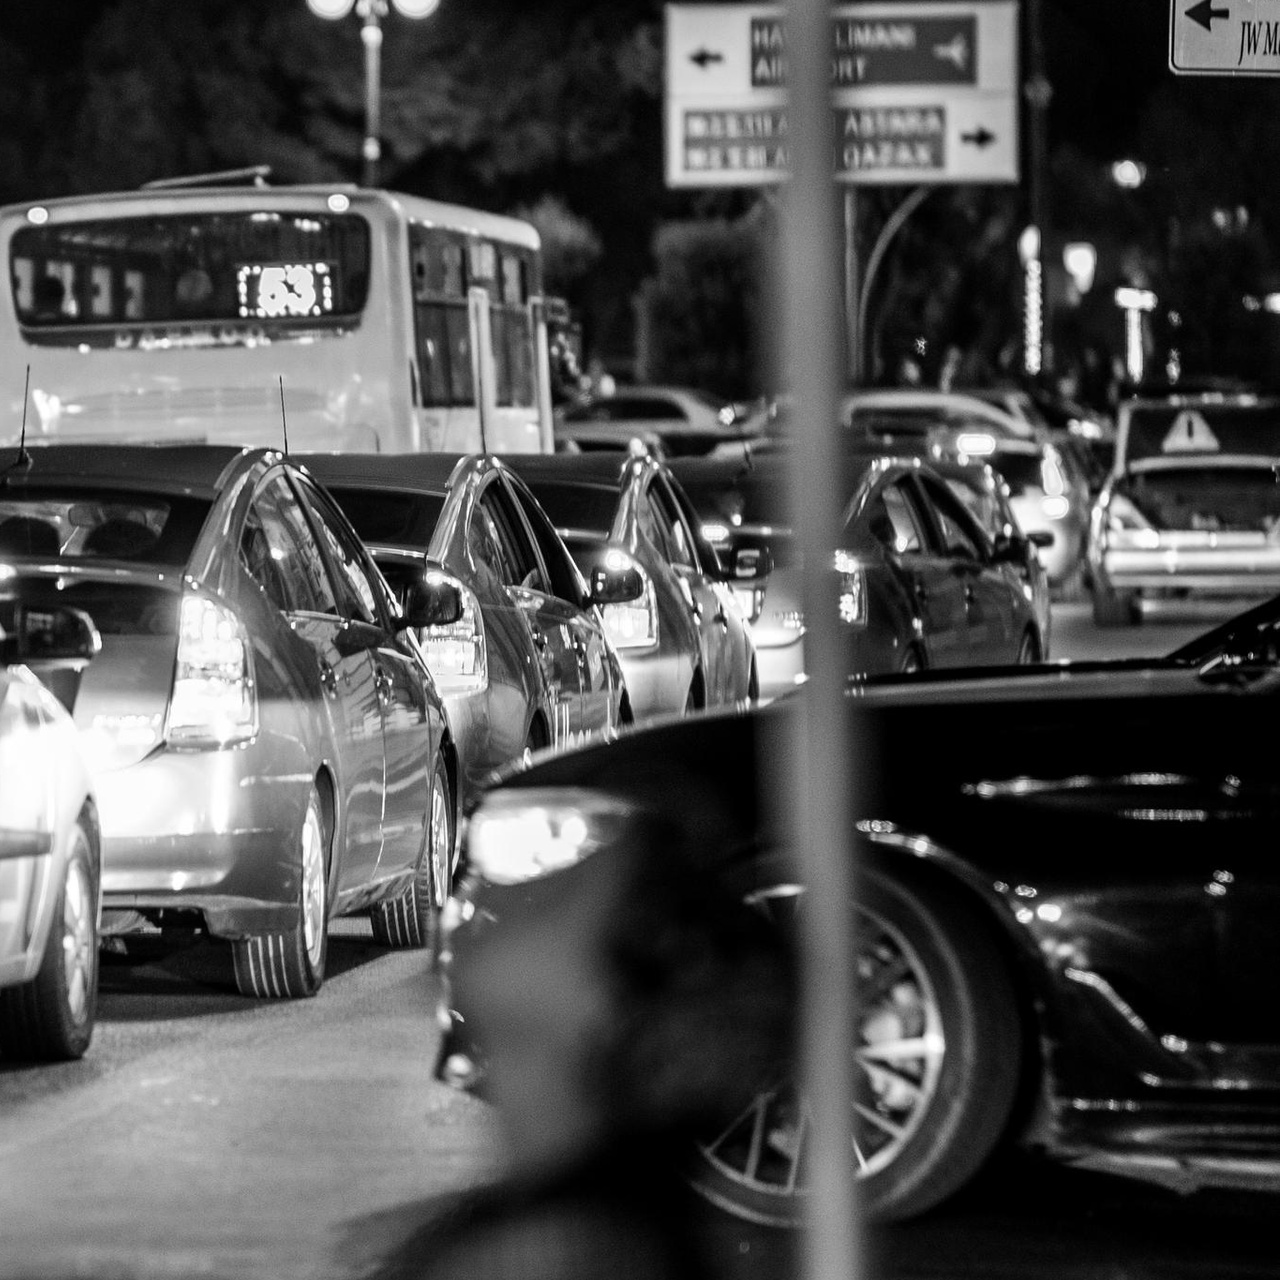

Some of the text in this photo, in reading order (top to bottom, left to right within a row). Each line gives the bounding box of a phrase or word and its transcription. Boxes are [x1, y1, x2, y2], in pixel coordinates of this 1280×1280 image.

[1237, 21, 1280, 66] JW M
[258, 266, 317, 317] 53
